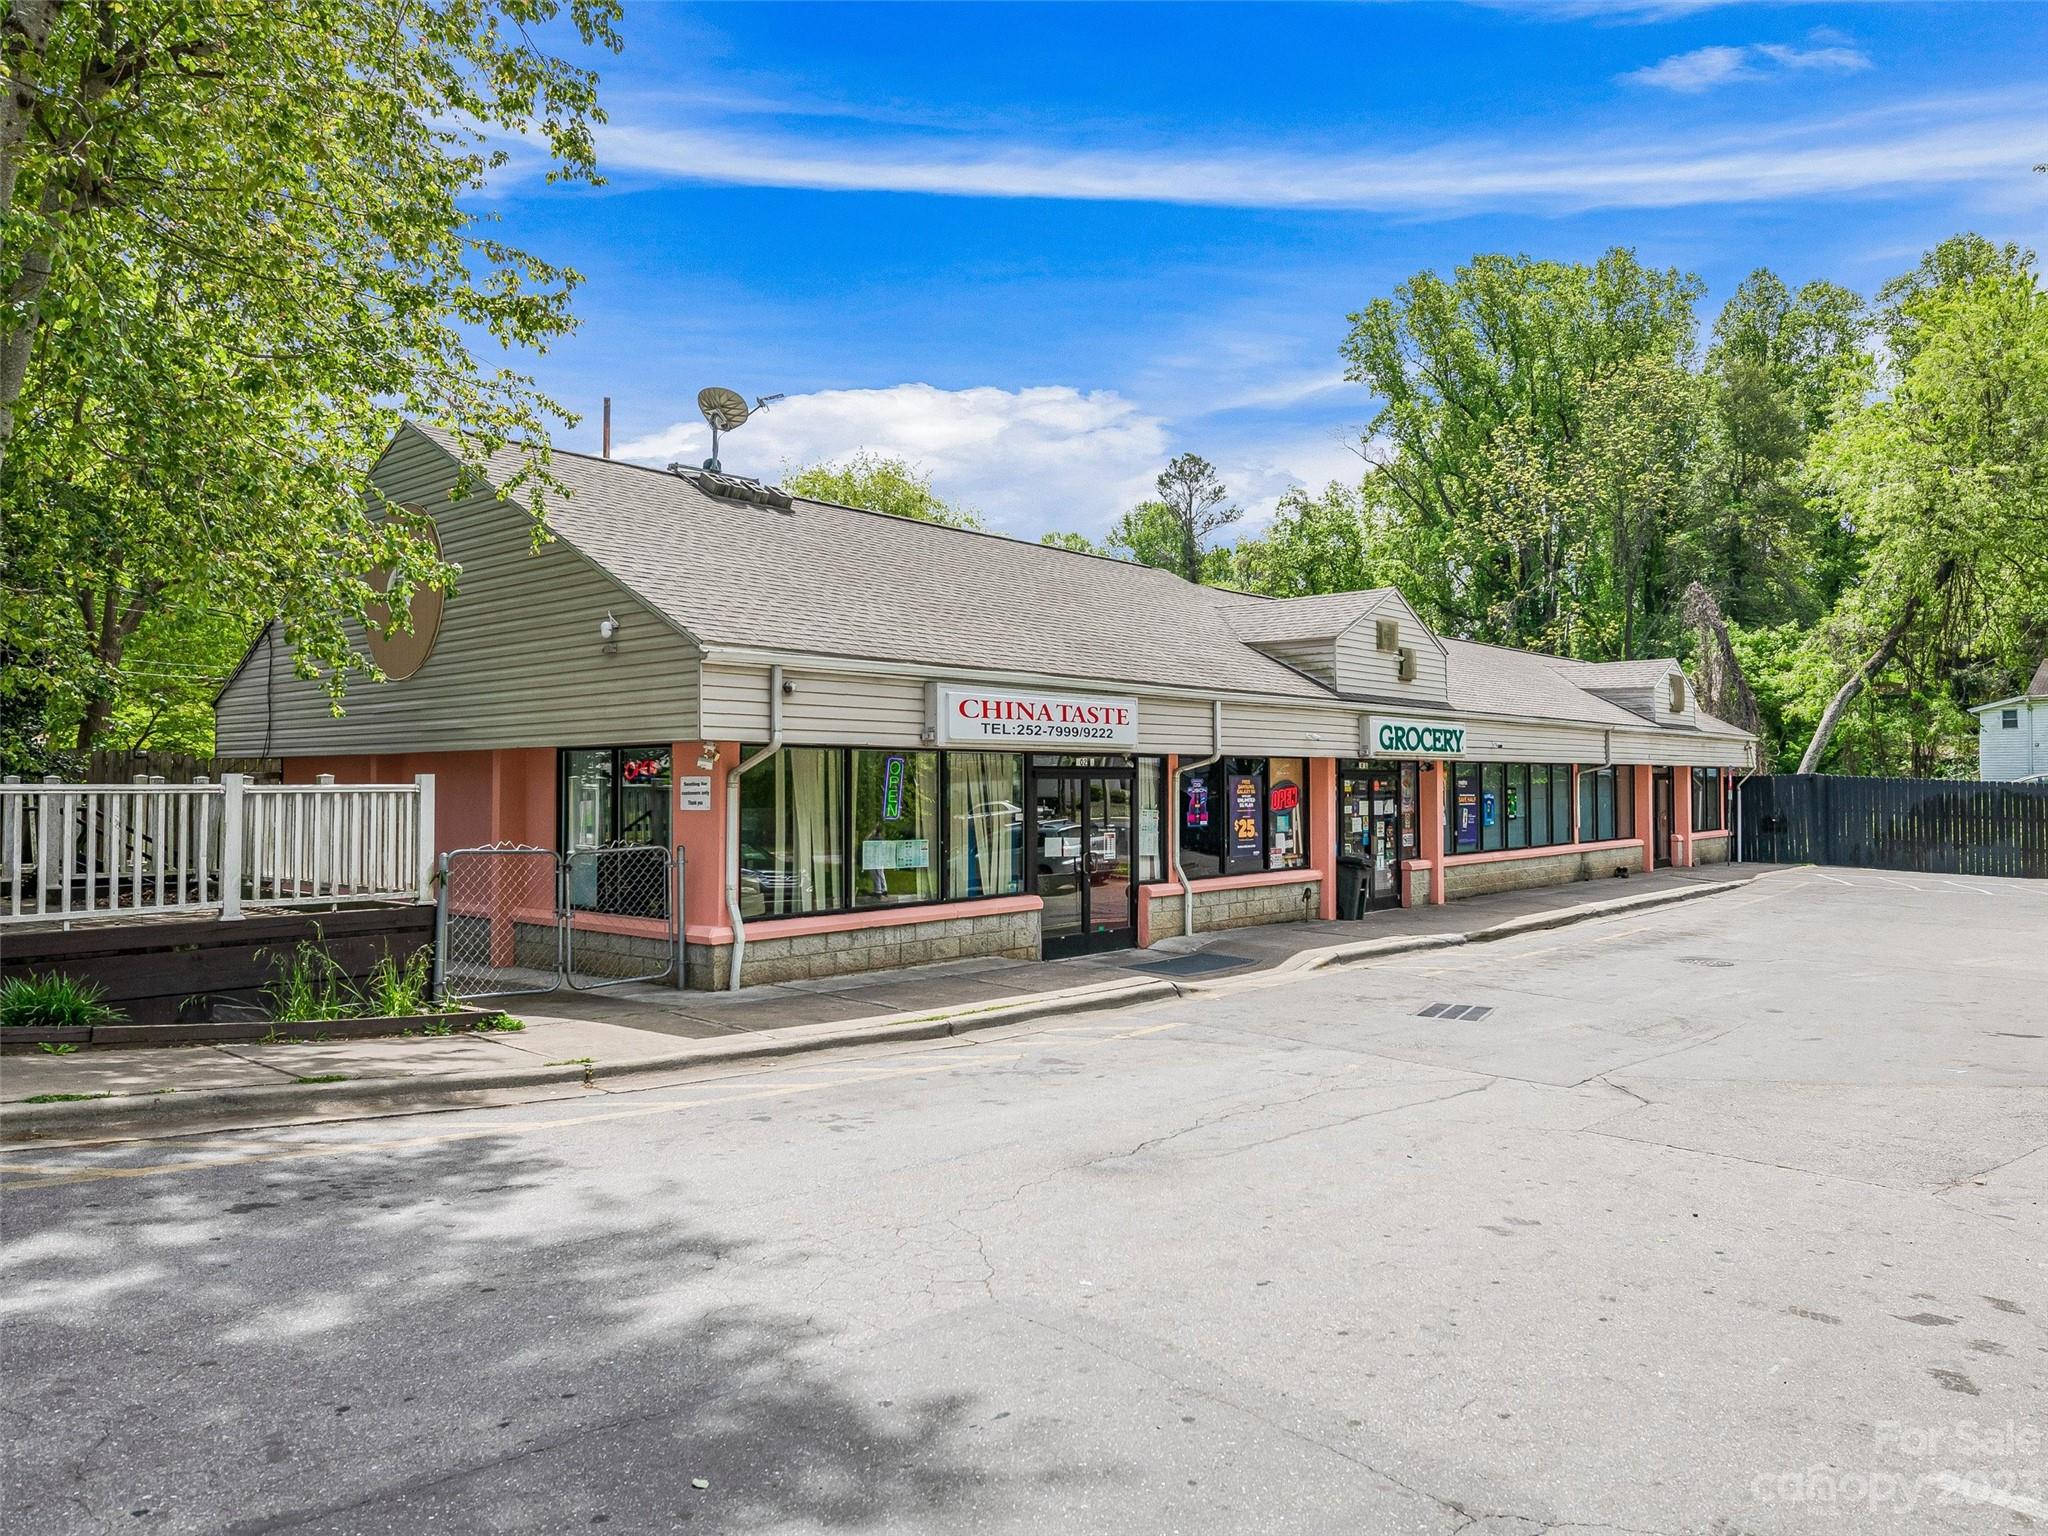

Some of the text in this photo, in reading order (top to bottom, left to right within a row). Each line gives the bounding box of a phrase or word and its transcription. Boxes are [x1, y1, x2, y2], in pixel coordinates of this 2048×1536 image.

[959, 699, 1130, 726] CHINA TASTE
[981, 722, 1113, 738] TEL:252-7999/9222
[1379, 724, 1464, 752] GROCERY
[886, 761, 901, 816] OPEN
[1271, 787, 1298, 809] OPEN
[1234, 819, 1256, 838] $25
